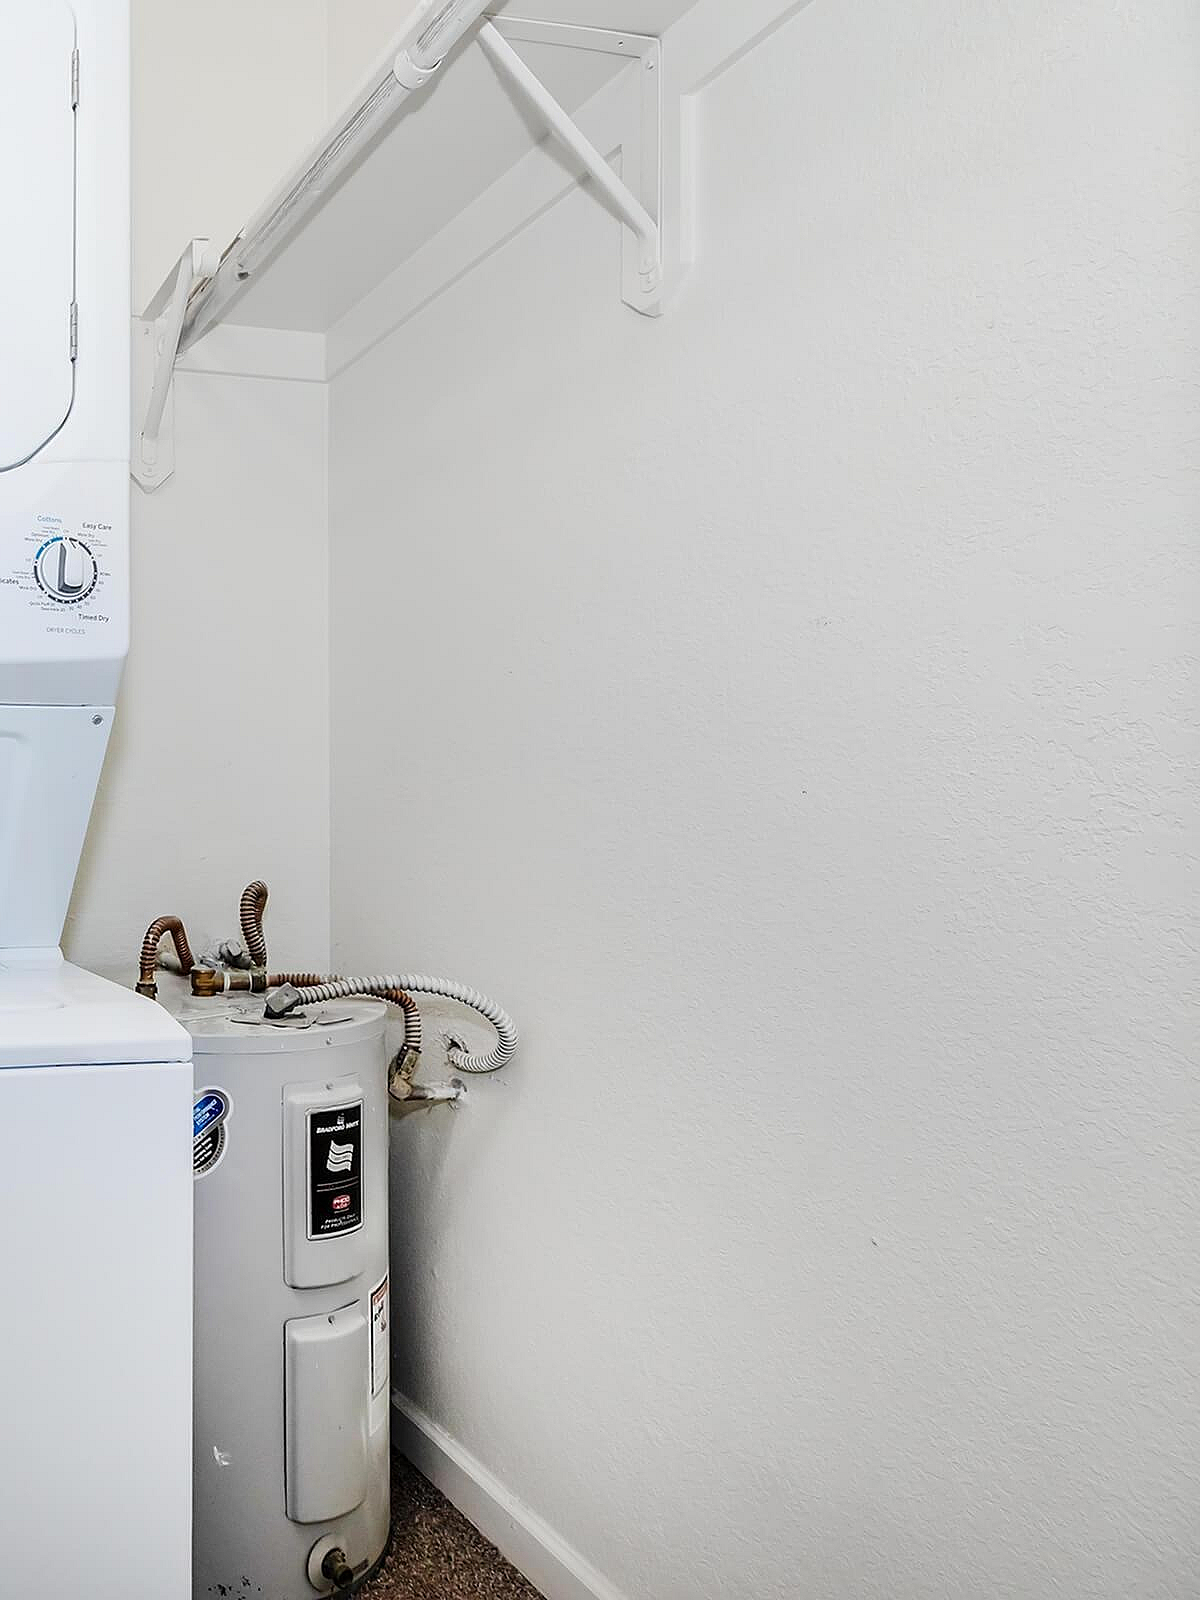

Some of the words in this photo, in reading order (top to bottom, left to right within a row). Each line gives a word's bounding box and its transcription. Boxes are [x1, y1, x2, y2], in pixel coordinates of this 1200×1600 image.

[37, 515, 62, 524] Cottons
[82, 522, 97, 531] Easy
[98, 523, 112, 531] Care
[97, 615, 110, 623] Dry
[316, 1124, 345, 1134] BRADFORD
